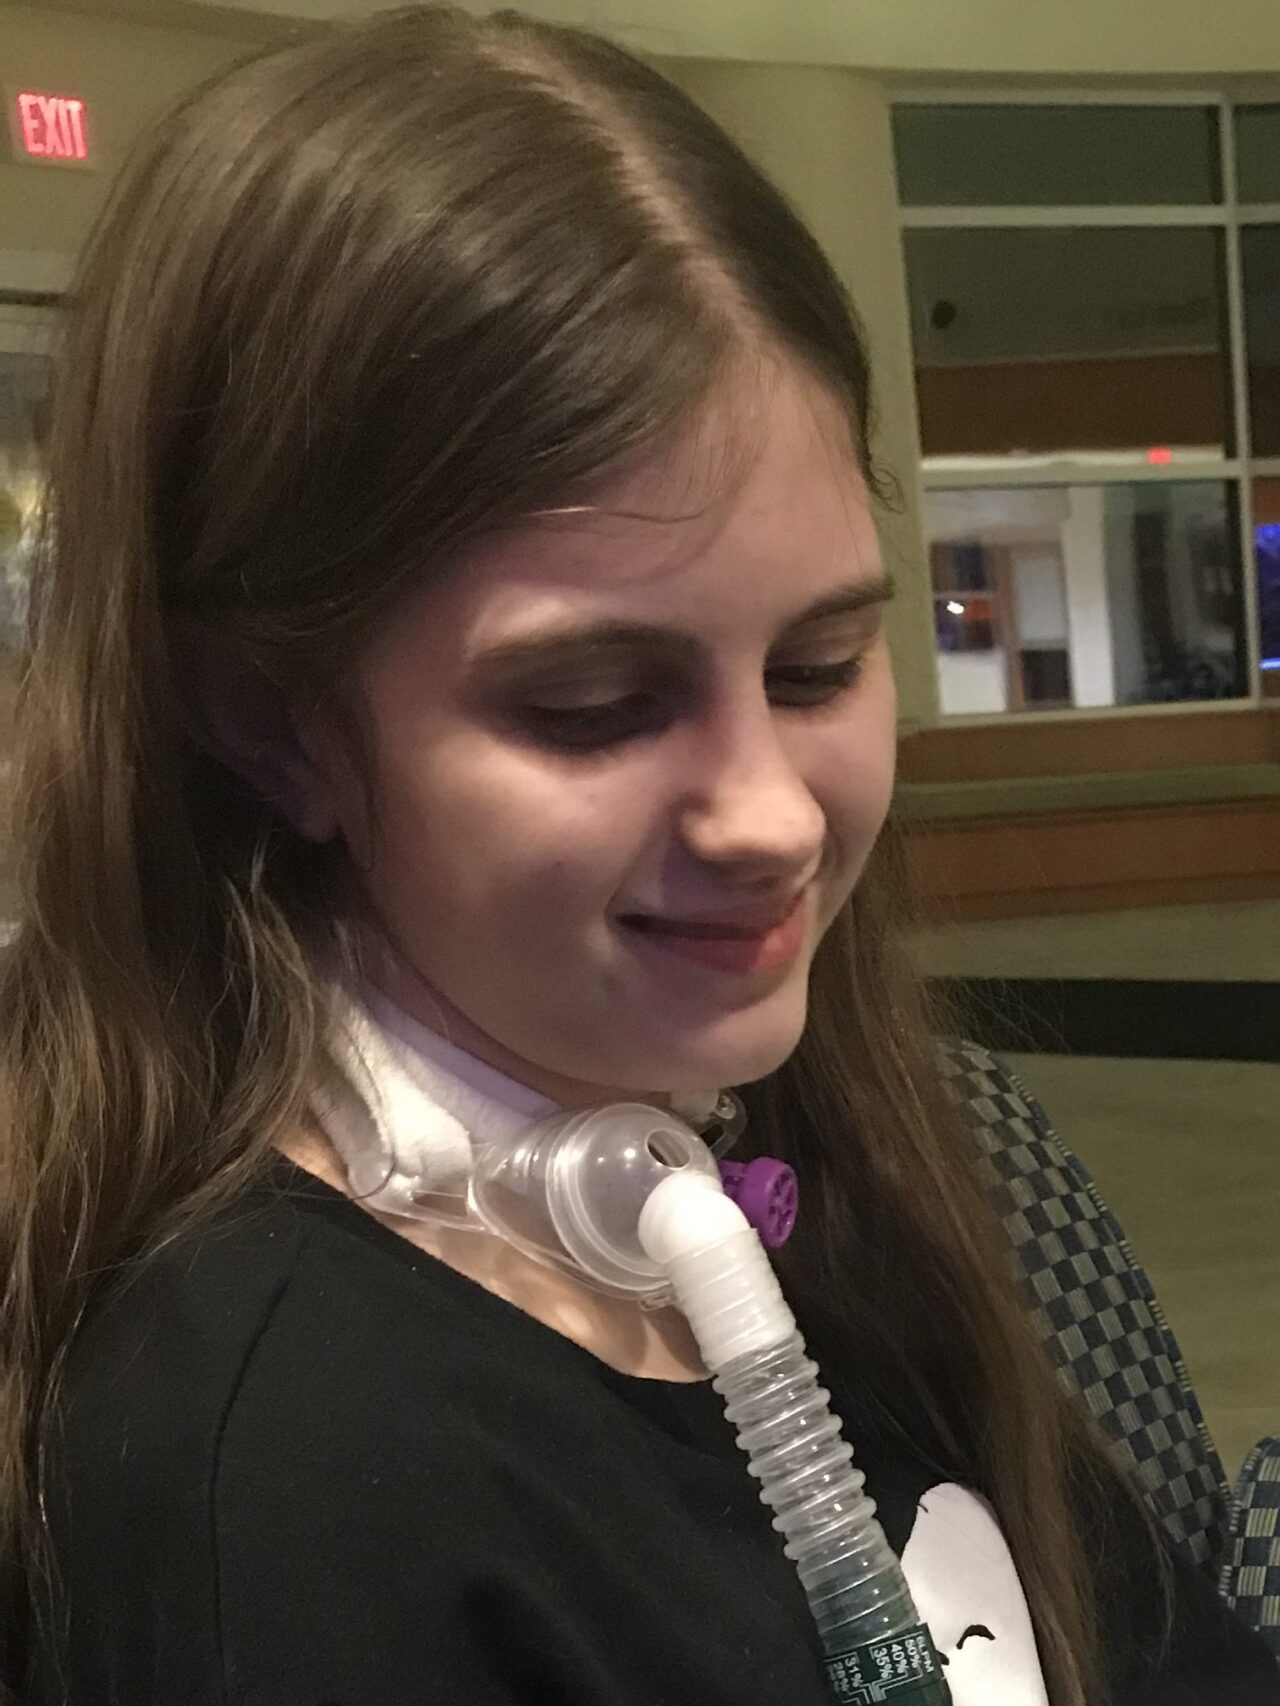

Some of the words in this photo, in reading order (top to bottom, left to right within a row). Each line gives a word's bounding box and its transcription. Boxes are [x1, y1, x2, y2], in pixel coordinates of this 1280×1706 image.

[19, 94, 86, 157] EXIT
[844, 1657, 863, 1688] 31%
[874, 1647, 894, 1679] 35%
[891, 1644, 909, 1674] 40%
